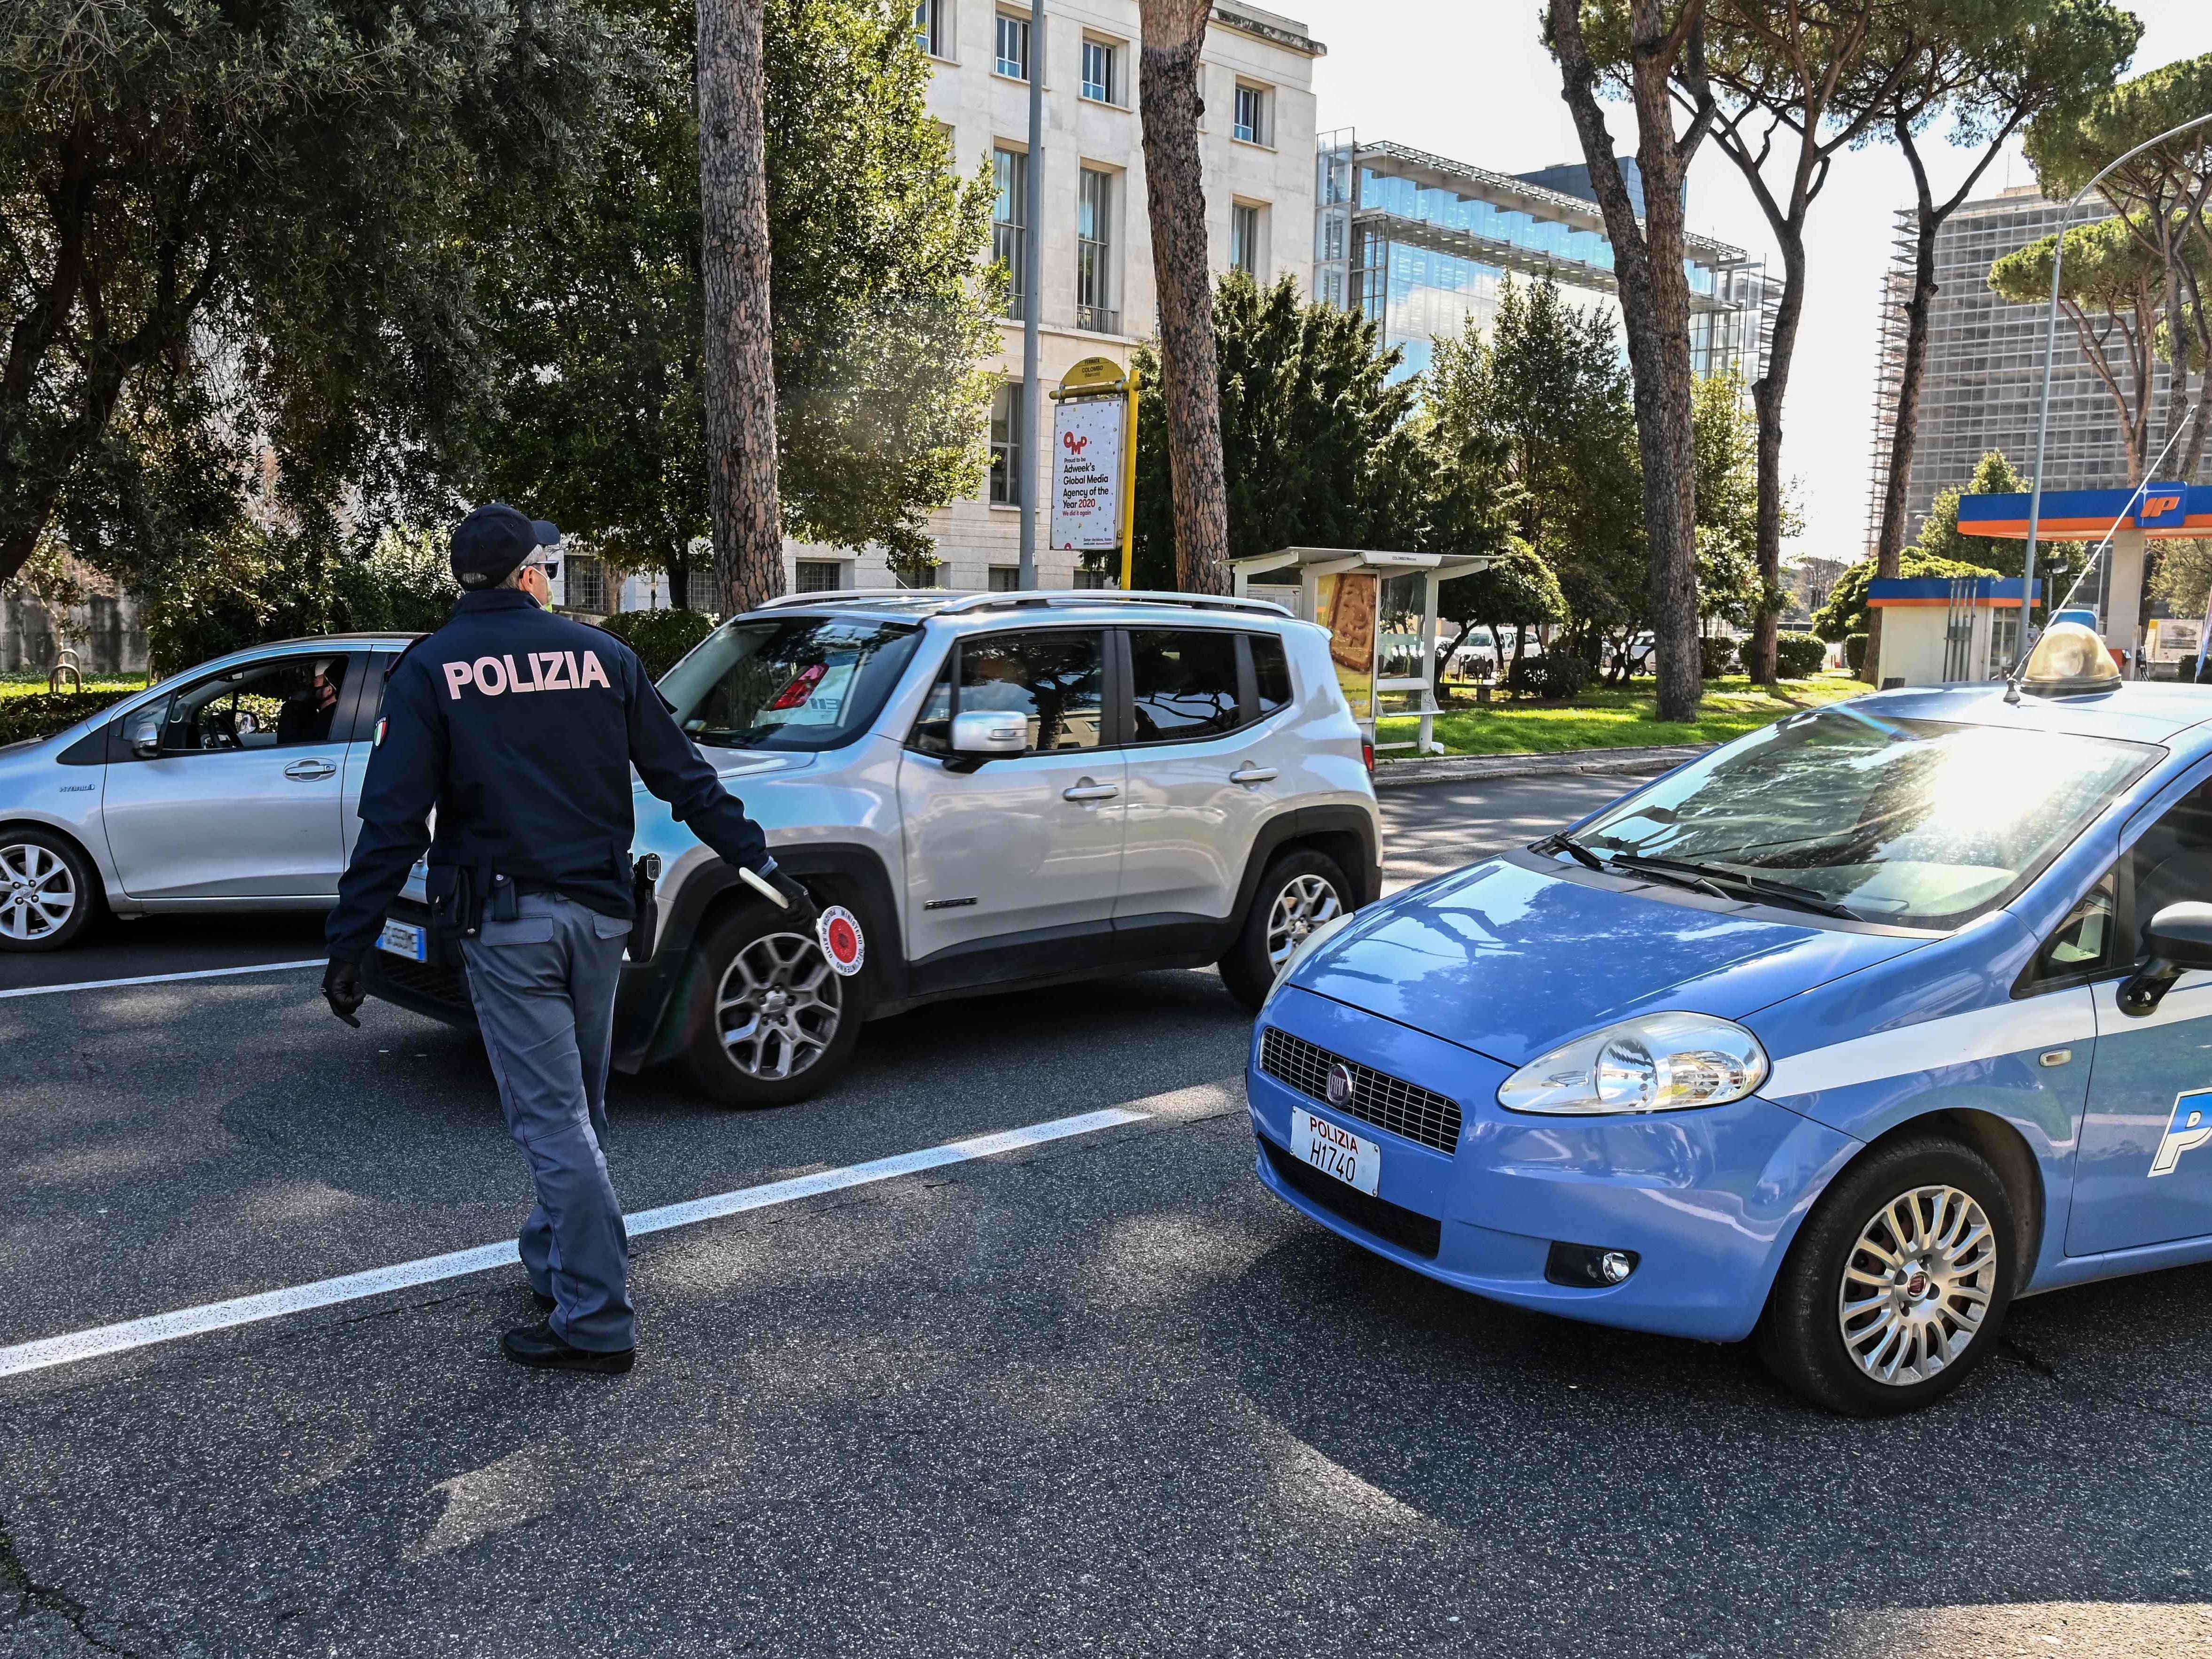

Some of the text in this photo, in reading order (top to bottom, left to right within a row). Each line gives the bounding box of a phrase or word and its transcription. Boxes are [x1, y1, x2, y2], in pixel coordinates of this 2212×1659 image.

[1063, 473, 1109, 485] Global Media
[1063, 488, 1088, 499] Agency
[1097, 486, 1109, 495] the
[1063, 498, 1095, 509] Year 2020
[2140, 496, 2180, 518] IP
[442, 651, 611, 700] POLIZIA
[1331, 1074, 1346, 1096] FIAT
[1310, 1116, 1358, 1155] POLIZIA
[1310, 1138, 1356, 1182] H1740
